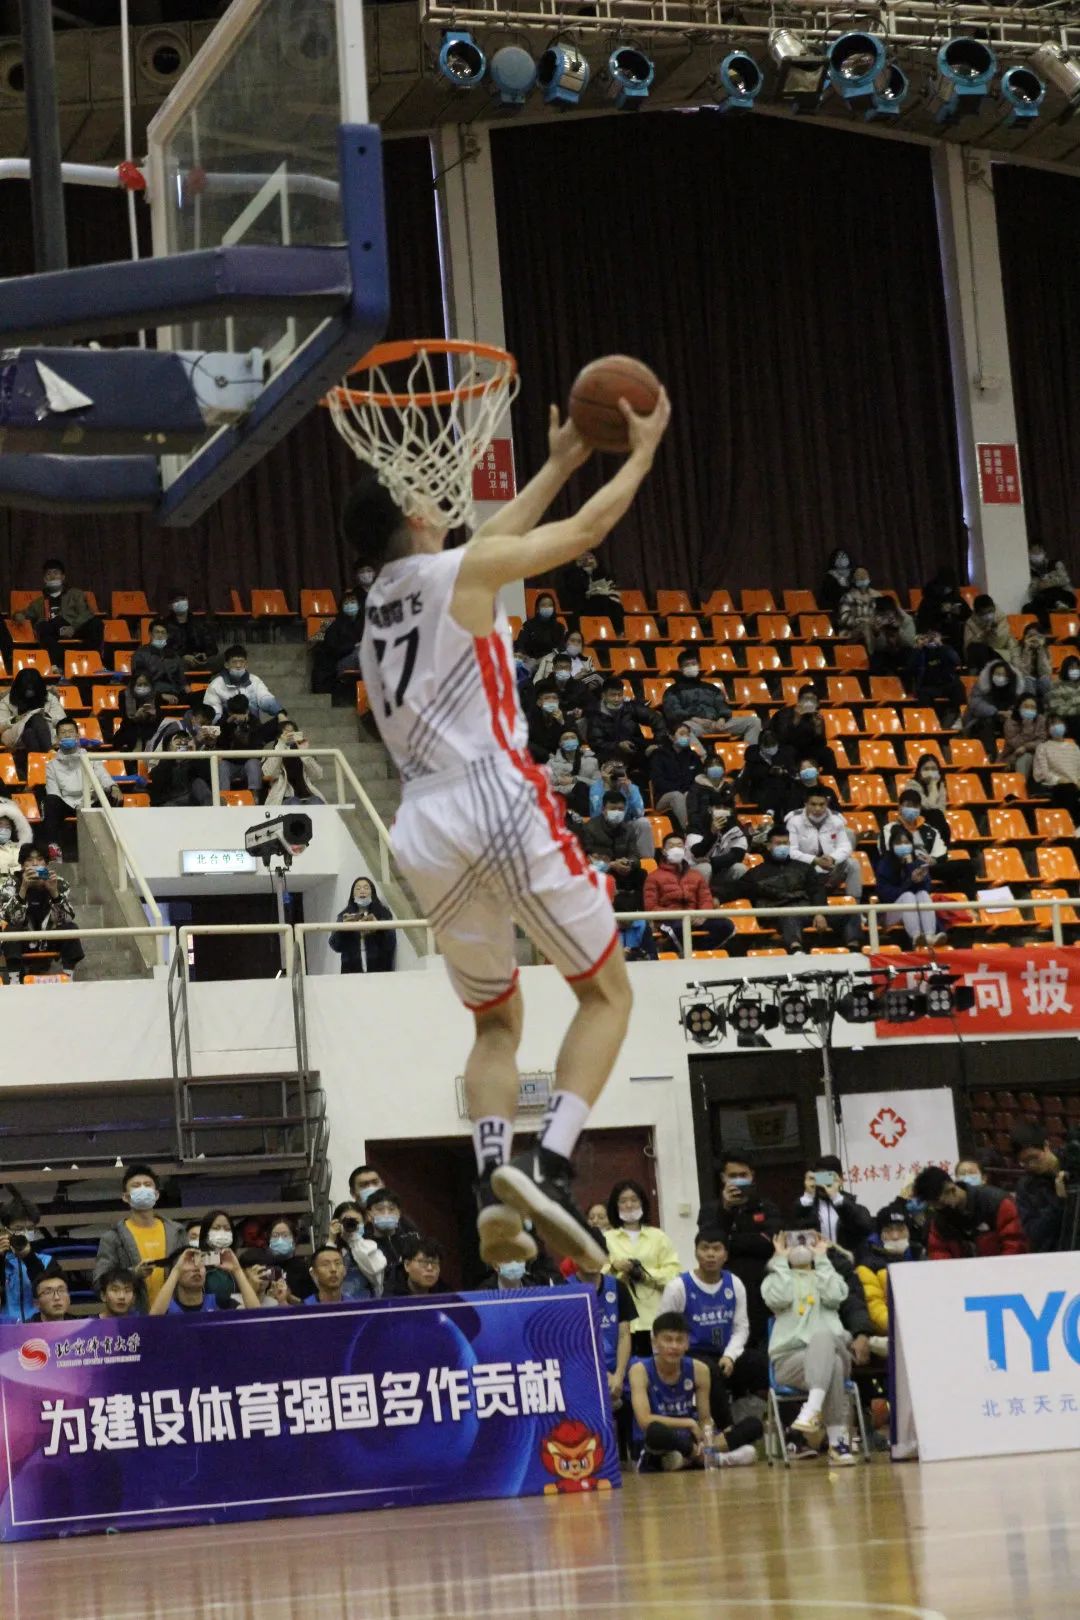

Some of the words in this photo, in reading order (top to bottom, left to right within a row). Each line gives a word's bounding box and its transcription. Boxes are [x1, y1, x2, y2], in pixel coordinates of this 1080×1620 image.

[55, 1332, 141, 1358] 北京体育大学
[40, 1358, 566, 1456] 为建设体育强国多作贡献
